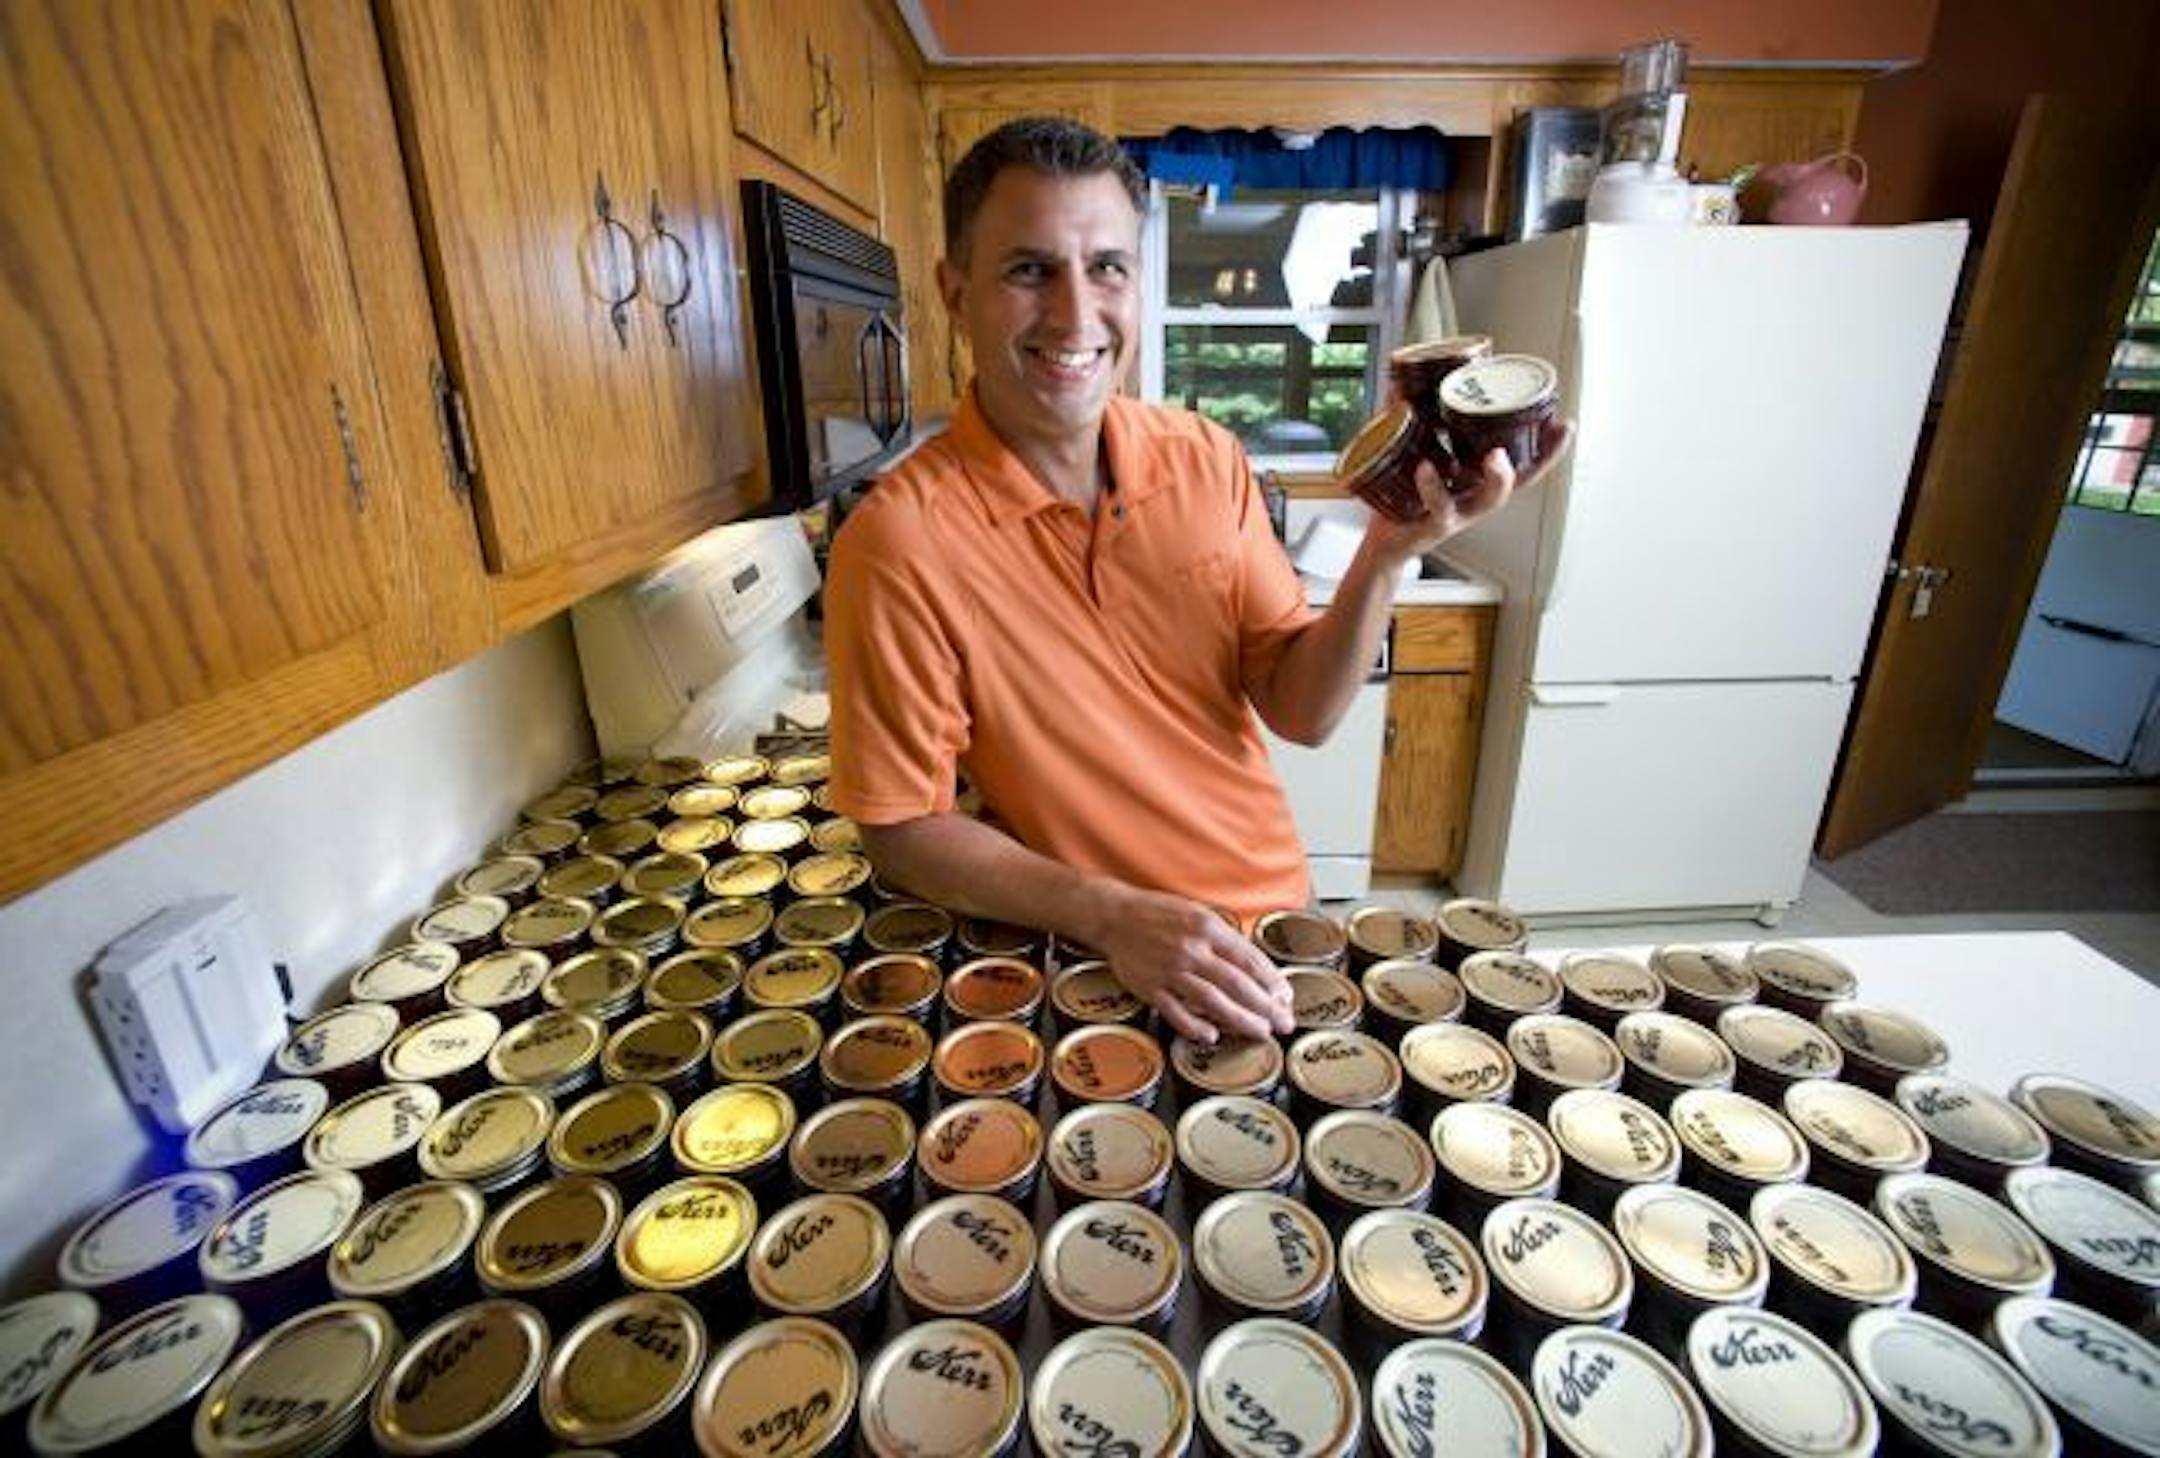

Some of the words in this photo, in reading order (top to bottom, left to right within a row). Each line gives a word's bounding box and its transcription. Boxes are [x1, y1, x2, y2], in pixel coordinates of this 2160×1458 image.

[966, 1061, 1026, 1086] Kerr
[1067, 1045, 1100, 1087] Kerr
[1303, 1039, 1363, 1063] Kerr
[1521, 1031, 1556, 1070] Kerr
[1442, 1064, 1499, 1091] Kerr
[1915, 1087, 1972, 1117] Kerr
[392, 1096, 426, 1139] Kerr
[441, 1106, 497, 1157] Kerr
[936, 1112, 983, 1165] Kerr
[1214, 1106, 1276, 1146] Kerr
[1619, 1110, 1664, 1163] Kerr
[1066, 1129, 1098, 1181] Kerr
[1327, 1156, 1402, 1194] Kerr
[351, 1200, 422, 1264] Kerr
[655, 1193, 730, 1220] Kerr
[227, 1210, 271, 1270] Kerr
[767, 1212, 835, 1268] Kerr
[951, 1210, 1010, 1263] Kerr
[1083, 1219, 1156, 1266] Kerr
[1270, 1211, 1315, 1279] Kerr
[1411, 1227, 1464, 1296] Kerr
[1502, 1216, 1561, 1264] Kerr
[2080, 1236, 2160, 1268] Kerr
[92, 1316, 199, 1375] Kerr
[397, 1323, 487, 1402] Kerr
[612, 1313, 682, 1361] Kerr
[1711, 1327, 1796, 1368] Kerr
[2034, 1315, 2158, 1388] Kerr
[910, 1346, 992, 1391] Kerr
[1555, 1351, 1615, 1418] Kerr
[739, 1389, 832, 1452] Kerr
[1058, 1401, 1142, 1458] Kerr
[1224, 1378, 1304, 1455] Kerr
[1395, 1372, 1437, 1458] Kerr
[1894, 1384, 2013, 1446] Kerr
